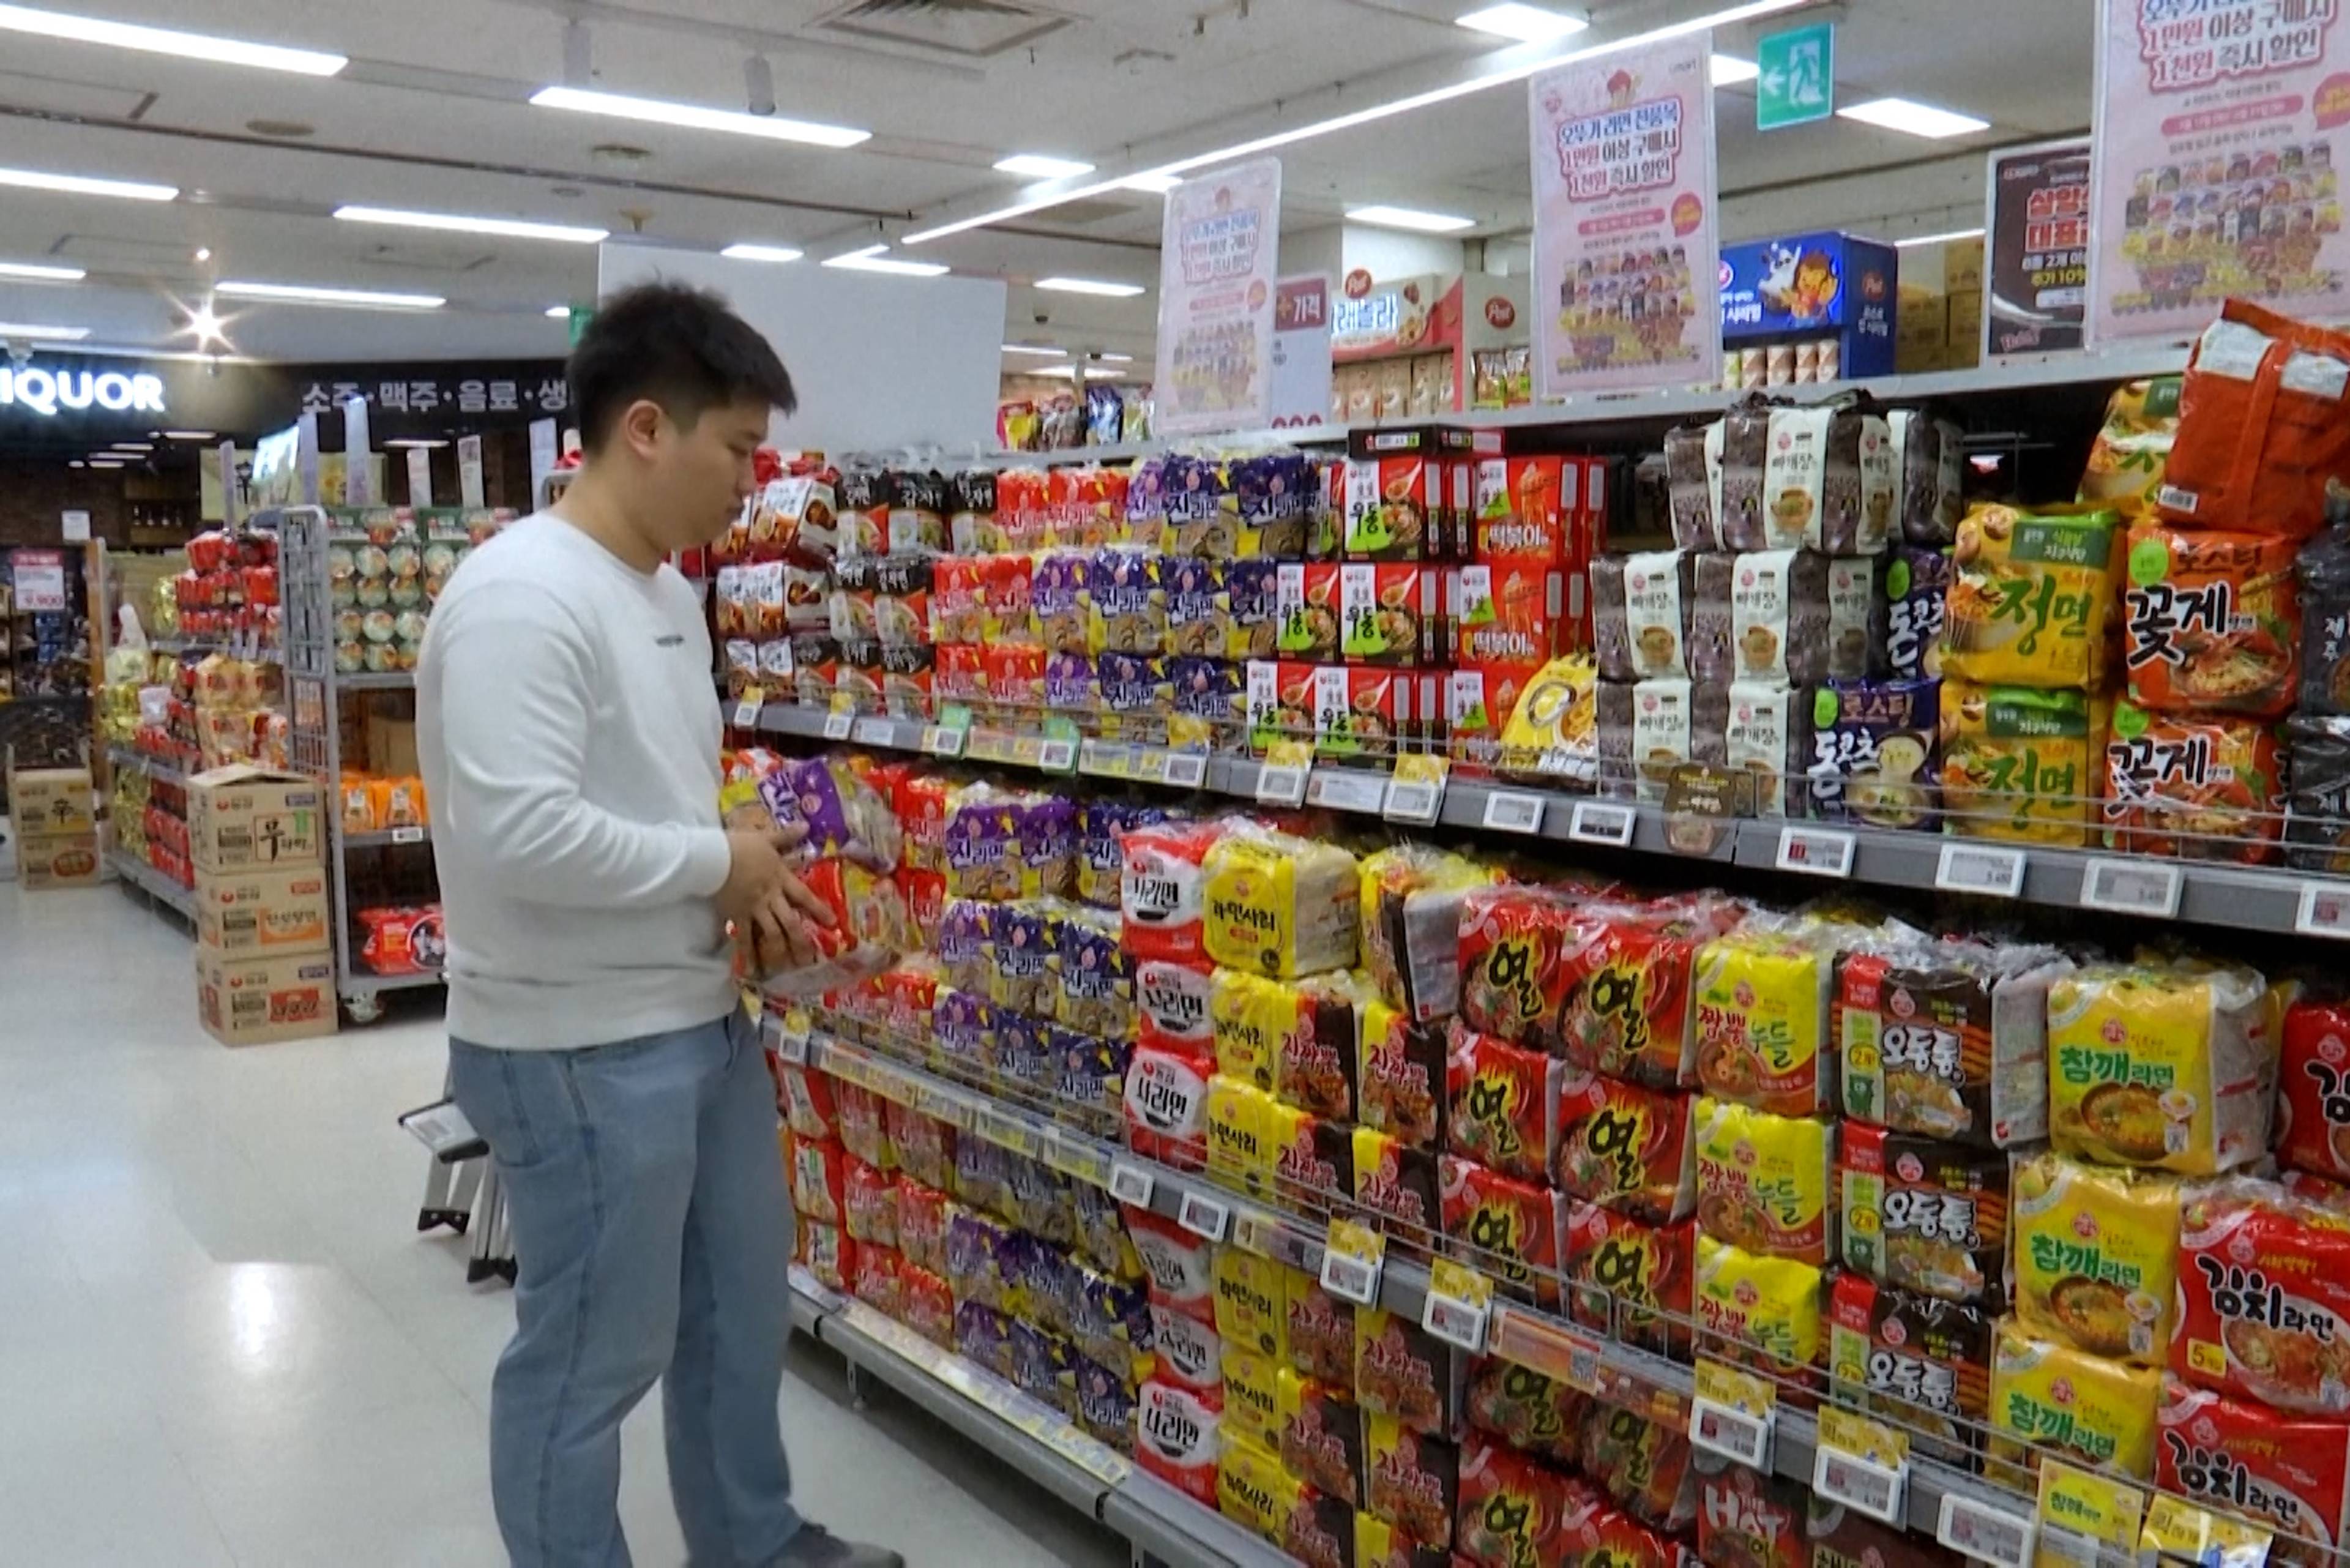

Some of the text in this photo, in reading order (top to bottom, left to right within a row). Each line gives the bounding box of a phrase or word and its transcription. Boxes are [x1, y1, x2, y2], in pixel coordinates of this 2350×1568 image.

[2209, 7, 2255, 40] 이상
[2269, 28, 2318, 61] 할인
[1988, 573, 2093, 656] 정면
[2059, 1044, 2174, 1086] 참깨라면
[2030, 1233, 2141, 1288] 참깨라면
[2197, 1255, 2334, 1342] 김치라면
[2008, 1391, 2116, 1460] 참깨라면
[2165, 1430, 2298, 1521] 김치라면
